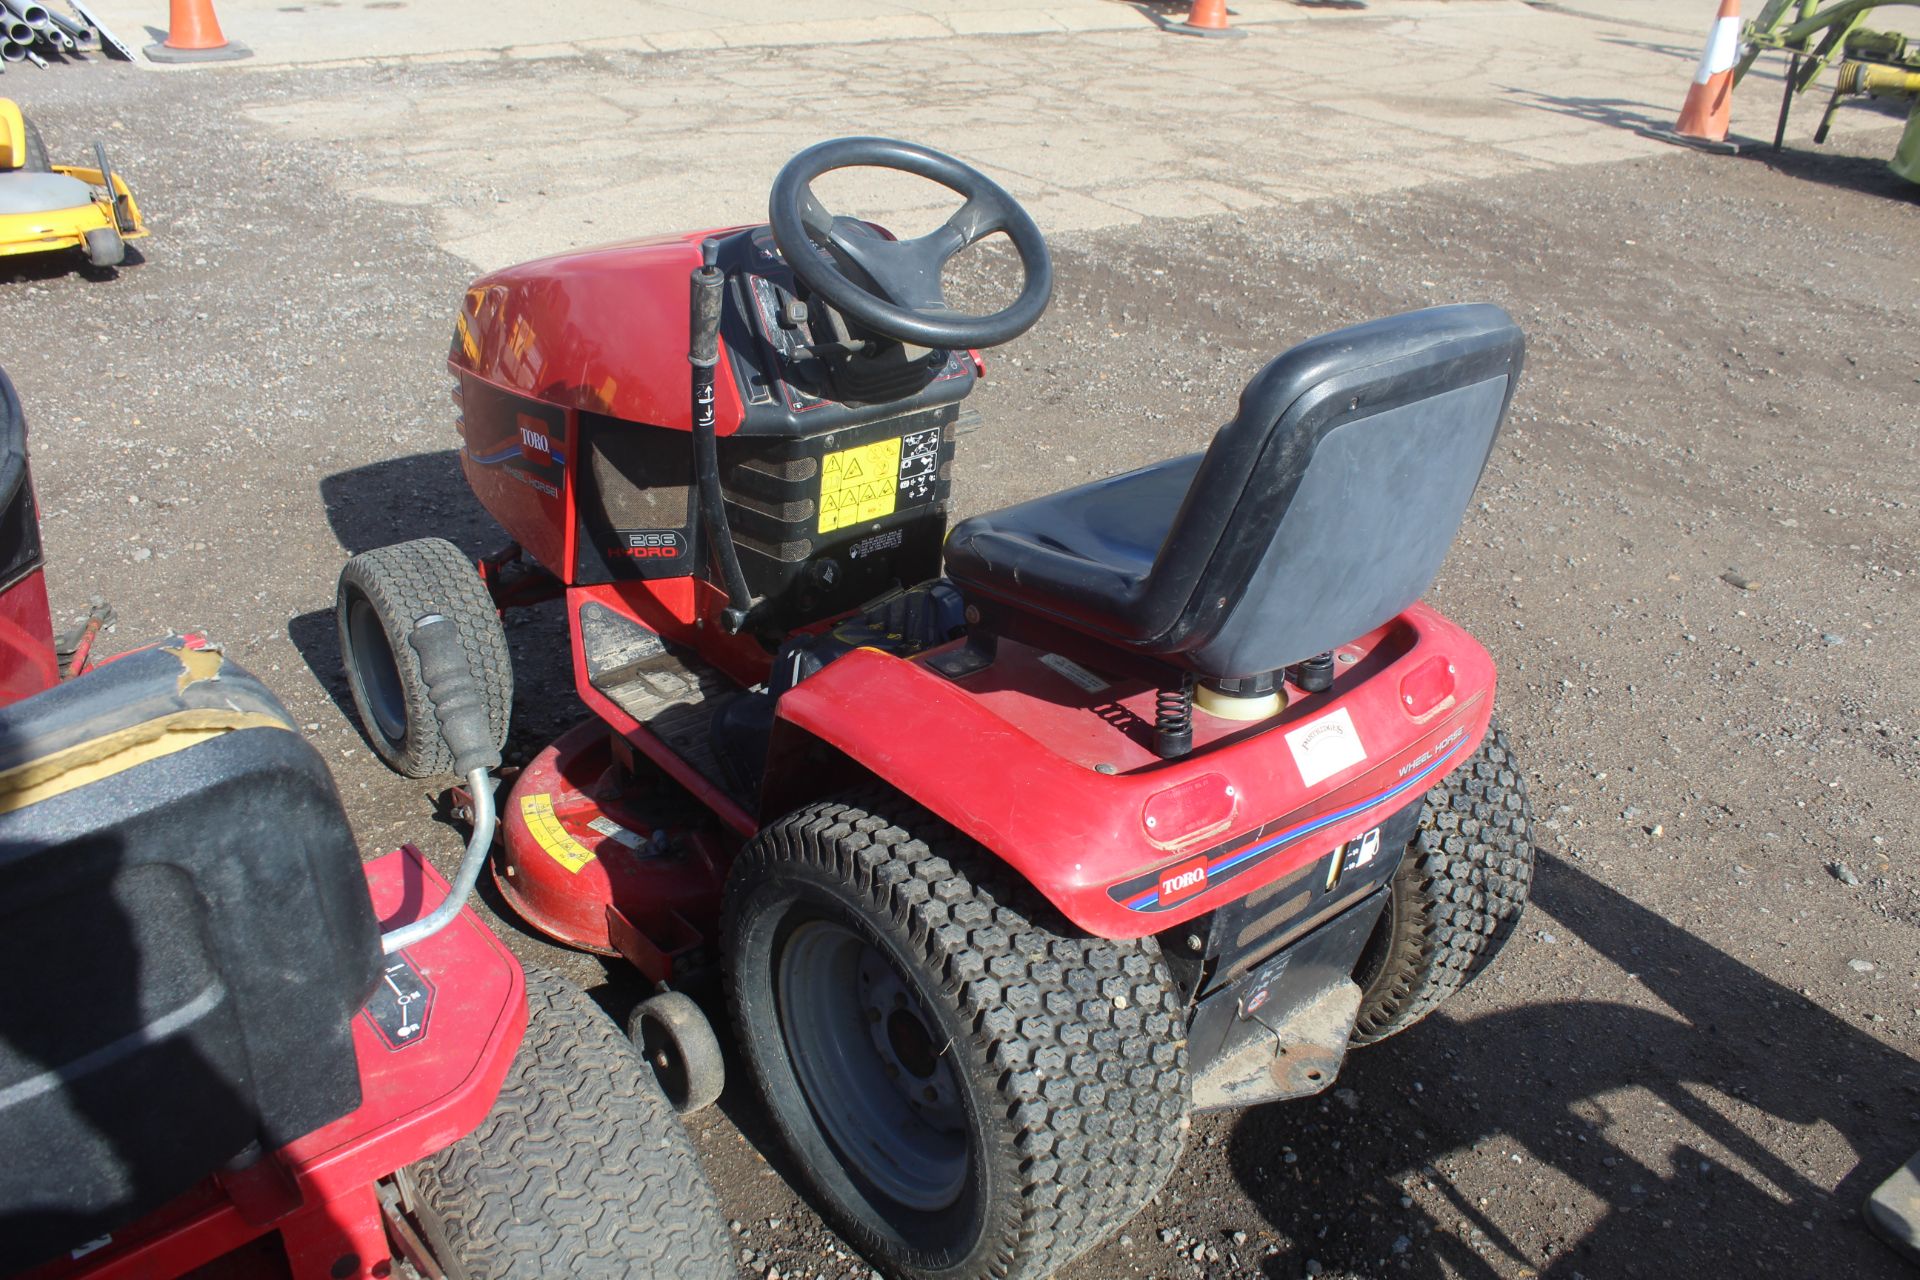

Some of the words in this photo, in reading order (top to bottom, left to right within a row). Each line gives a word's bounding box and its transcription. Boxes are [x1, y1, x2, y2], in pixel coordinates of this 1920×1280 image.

[520, 427, 549, 452] TORO
[503, 463, 527, 484] WHEEL
[528, 476, 556, 497] HORSE
[608, 546, 677, 558] HYDRO
[629, 533, 676, 547] 266
[1398, 751, 1433, 777] WHEEL
[1434, 725, 1465, 754] HORSE
[1162, 867, 1205, 895] TORO
